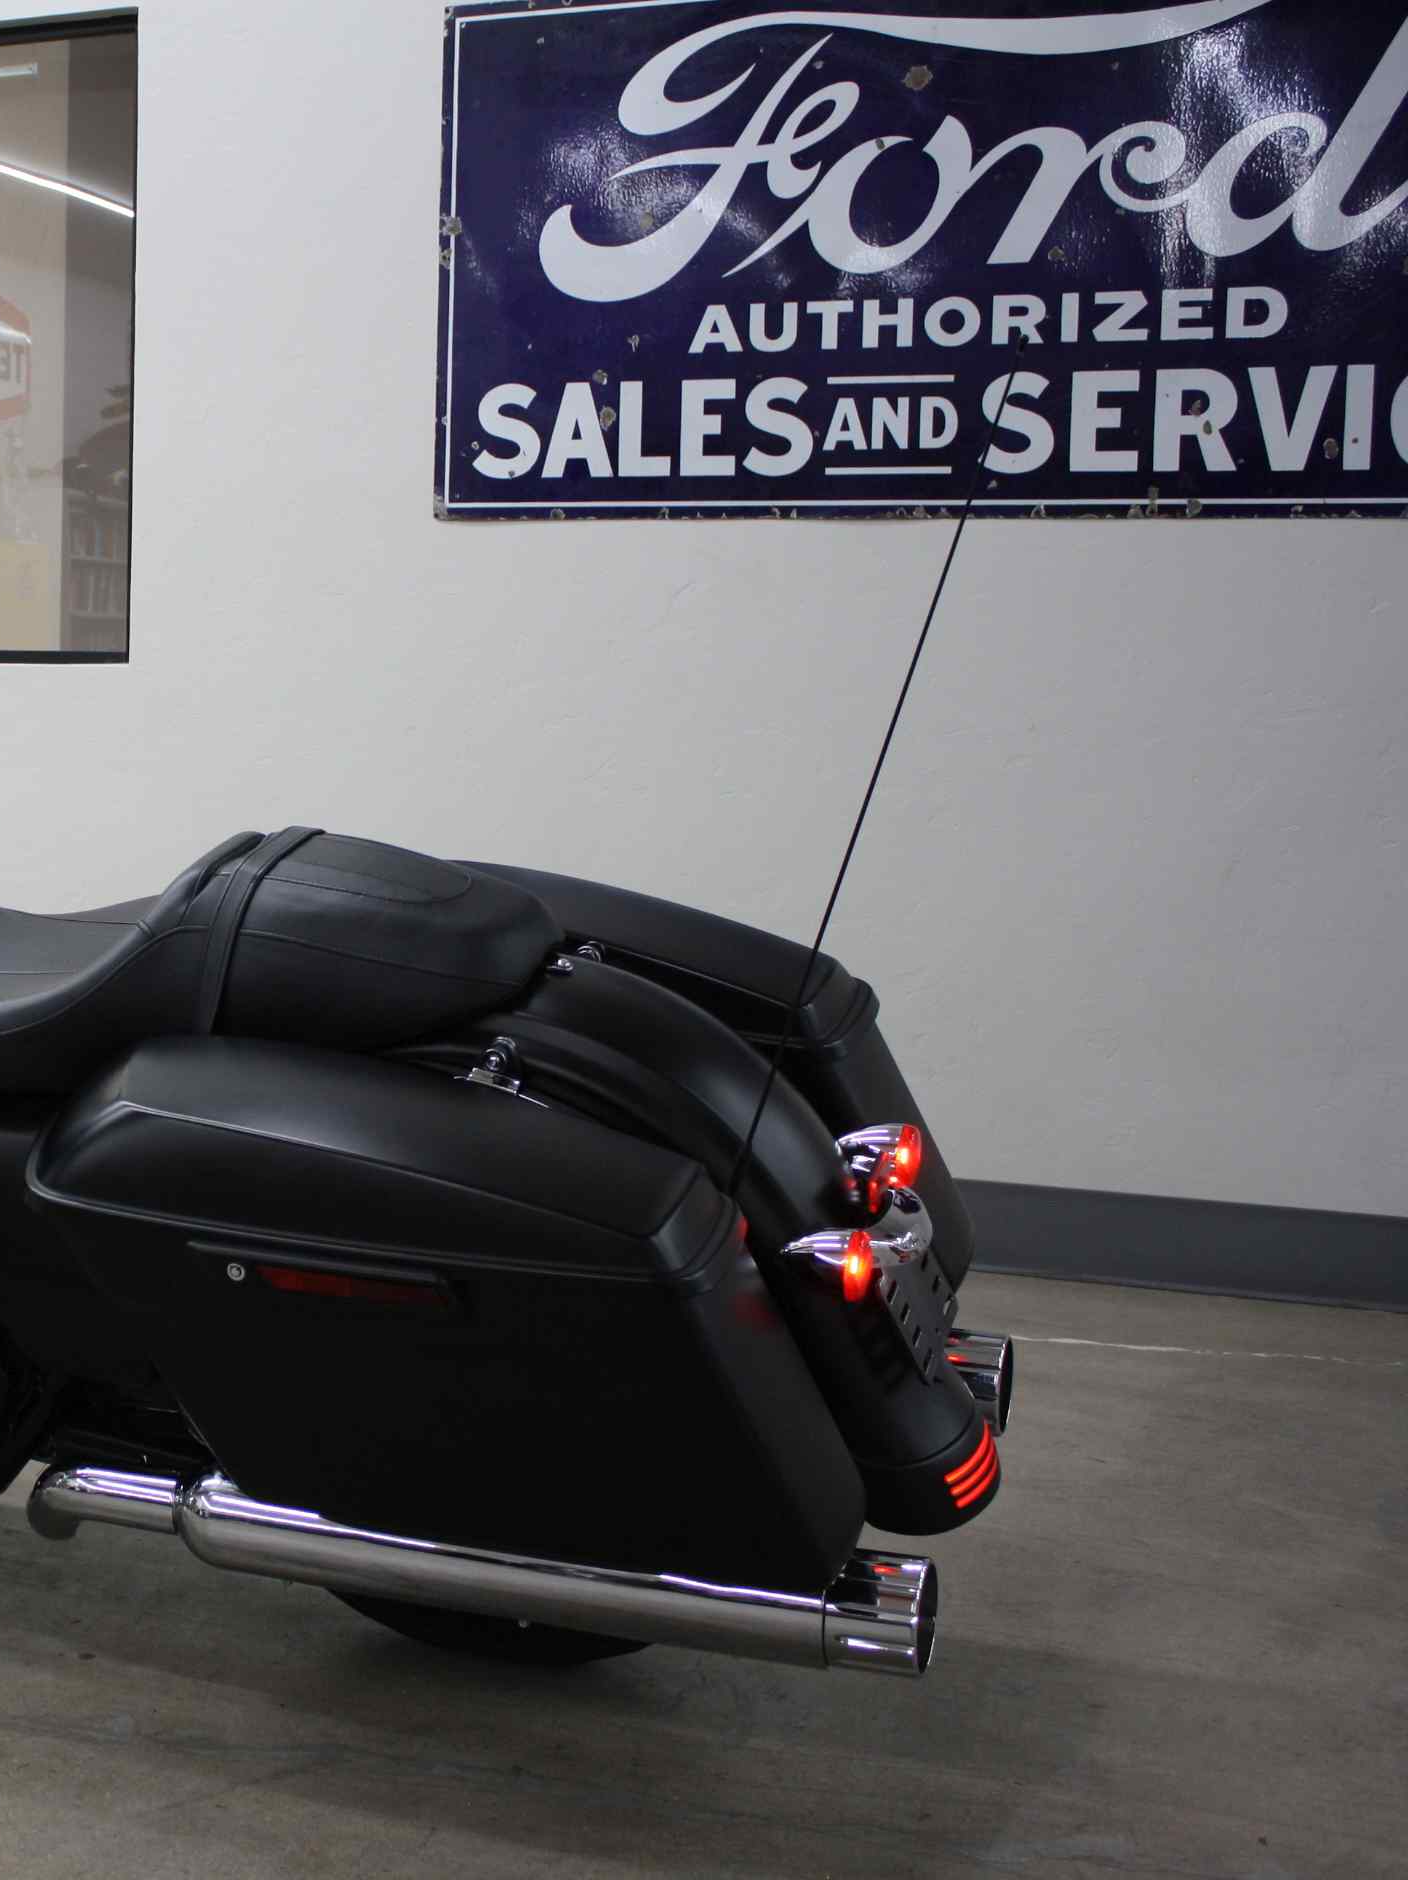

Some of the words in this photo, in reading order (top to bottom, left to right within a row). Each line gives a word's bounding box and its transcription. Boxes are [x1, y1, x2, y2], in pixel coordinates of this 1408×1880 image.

[539, 0, 1408, 302] Ford
[688, 286, 1289, 354] AUTHORIZED
[472, 376, 814, 479] SALES
[823, 396, 959, 451] AND
[978, 364, 1408, 475] SERVI
